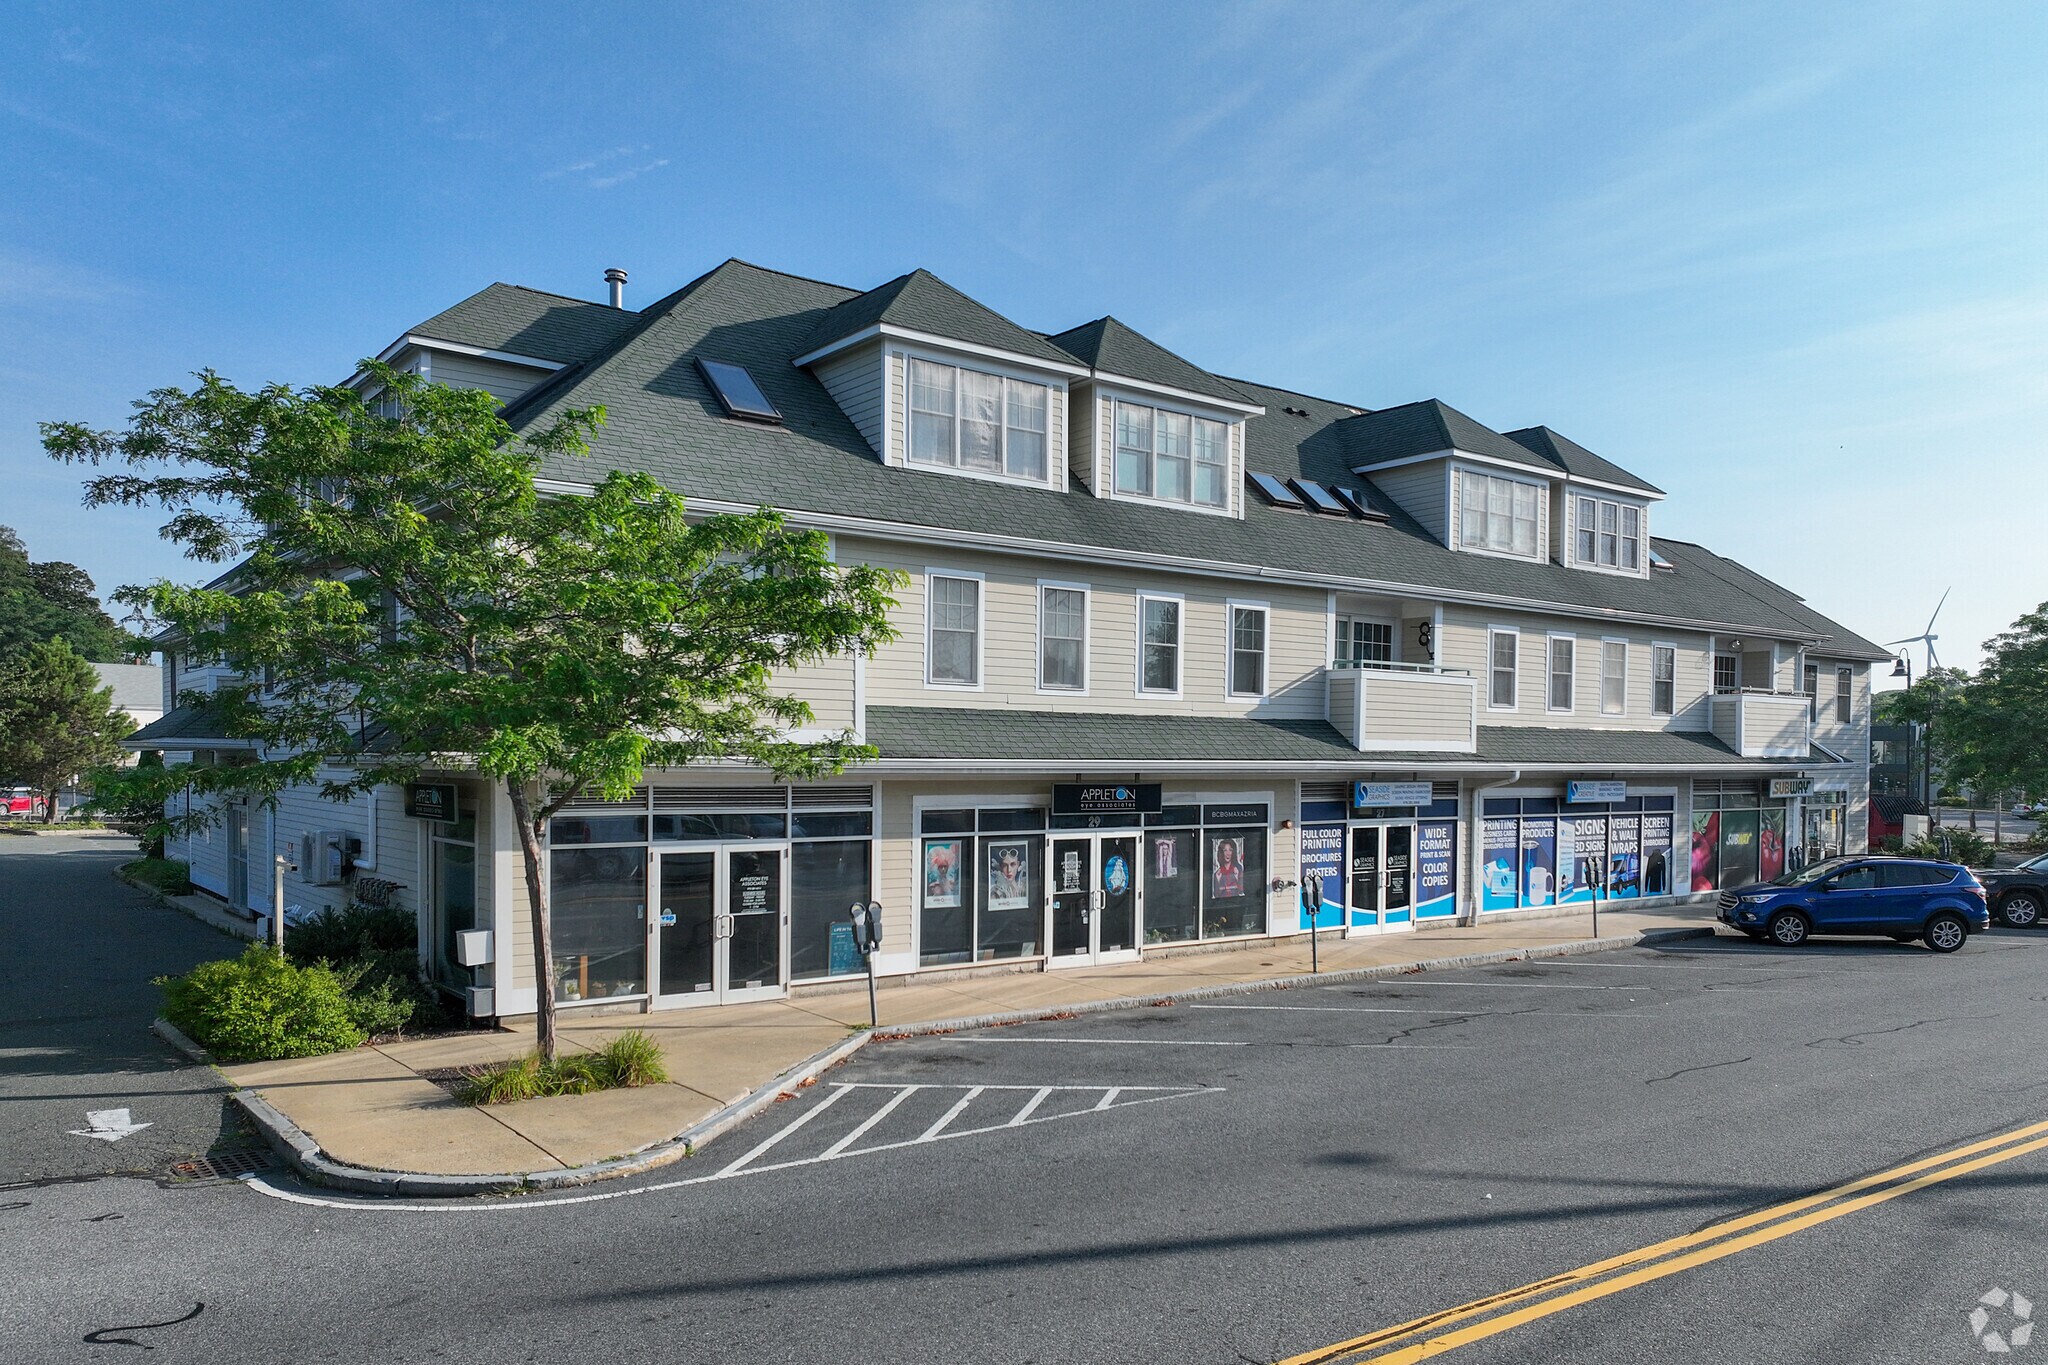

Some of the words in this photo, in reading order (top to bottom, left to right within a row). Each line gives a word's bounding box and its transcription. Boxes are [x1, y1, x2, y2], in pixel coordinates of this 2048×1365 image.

[1773, 781, 1811, 794] SUBWAY
[1081, 788, 1135, 800] APPLETON
[1377, 809, 1385, 818] 27
[1088, 816, 1100, 828] 29
[1483, 819, 1517, 830] PRINTING
[1575, 819, 1606, 835] SIGNS
[1612, 818, 1638, 829] VEHICLE
[1644, 817, 1669, 828] SCREEN
[1302, 830, 1318, 838] FULL
[1319, 829, 1342, 838] COLOR
[1424, 828, 1447, 838] WIDE
[1522, 828, 1554, 838] PRODUCTS
[1612, 831, 1618, 841] &
[1619, 830, 1638, 840] WALL
[1644, 829, 1669, 838] PRINTING
[1726, 832, 1752, 845] SUBWAY
[1302, 839, 1342, 849] PRINTING
[1420, 839, 1450, 850] FORMAT
[1575, 841, 1584, 852] 3D
[1586, 840, 1605, 851] SIGNS
[1611, 842, 1638, 854] WRAPS
[1302, 853, 1342, 863] BROCHURES
[1306, 867, 1338, 877] POSTERS
[1423, 862, 1448, 874] COLOR
[1422, 875, 1448, 887] COPIES
